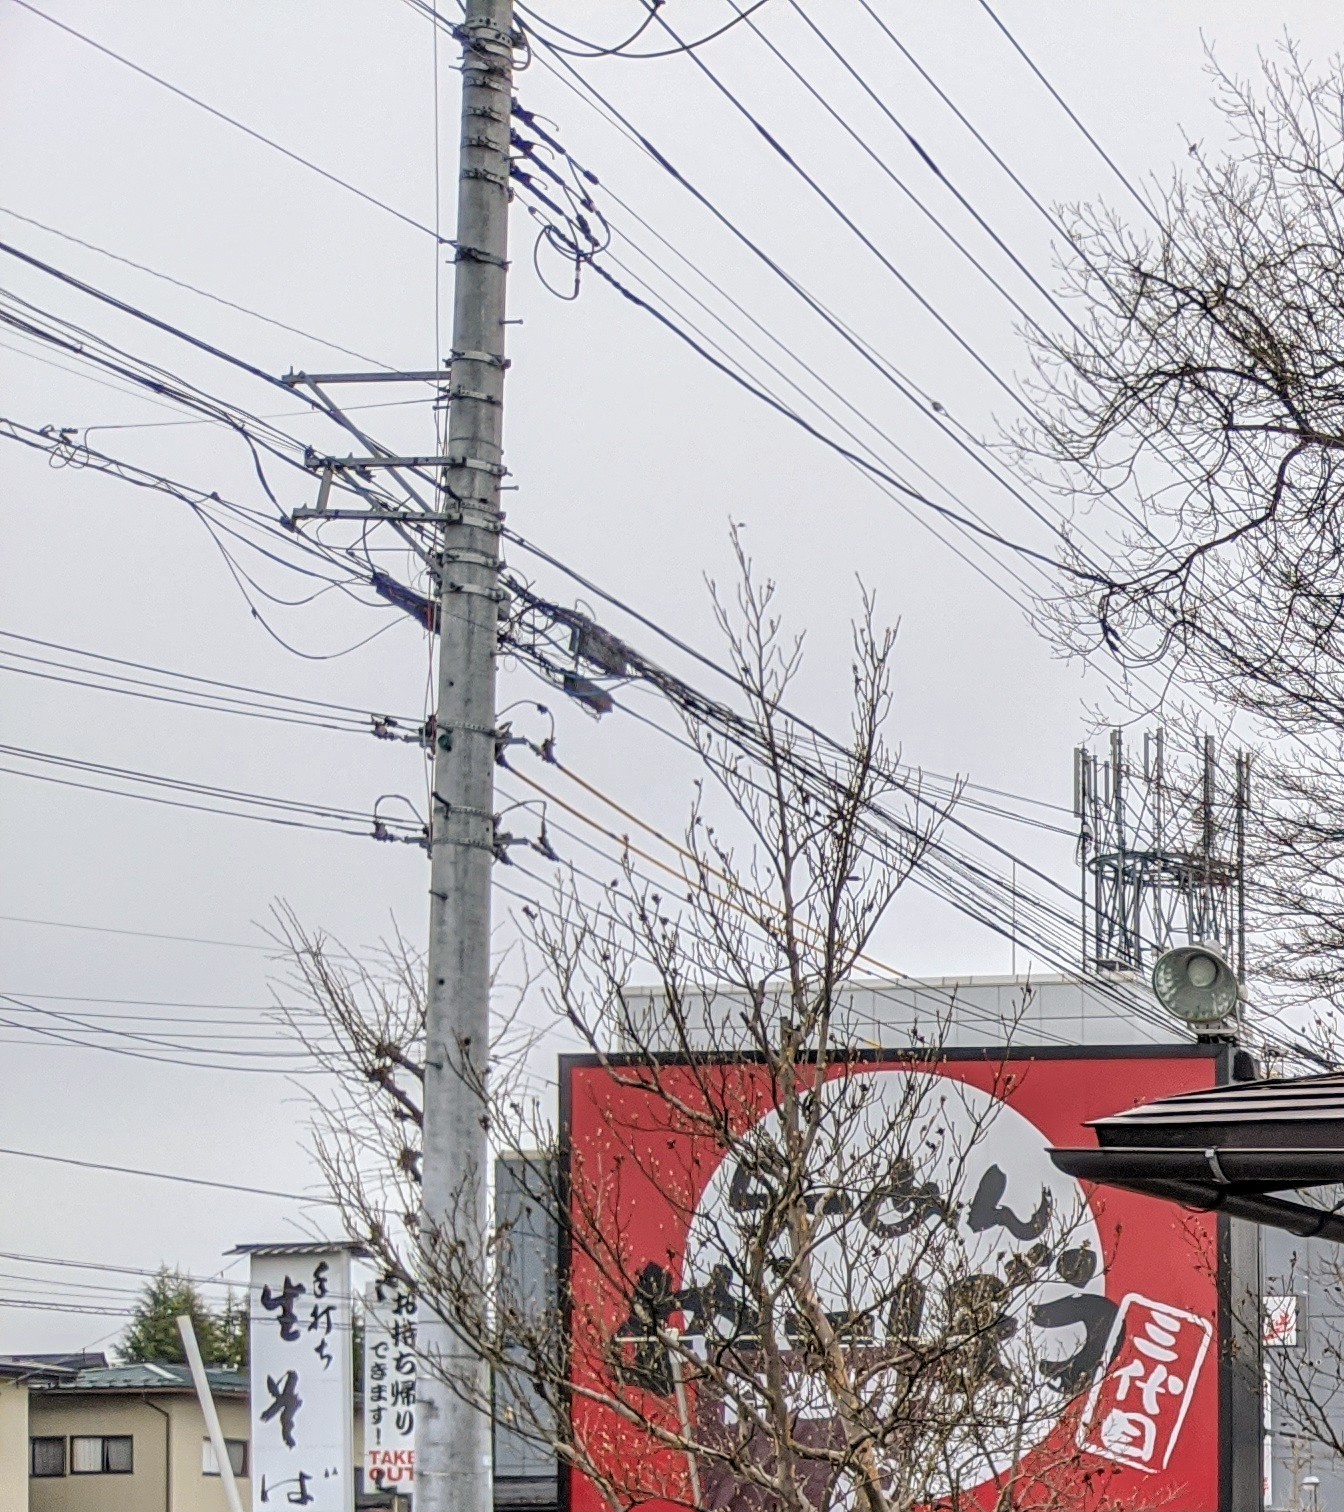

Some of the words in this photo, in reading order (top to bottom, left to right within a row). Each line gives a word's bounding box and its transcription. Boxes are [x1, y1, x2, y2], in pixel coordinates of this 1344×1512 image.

[307, 1261, 337, 1370] 手打ち
[391, 1292, 418, 1436] お持ち帰り
[1100, 1308, 1184, 1462] 三代目
[368, 1450, 415, 1466] TAKE
